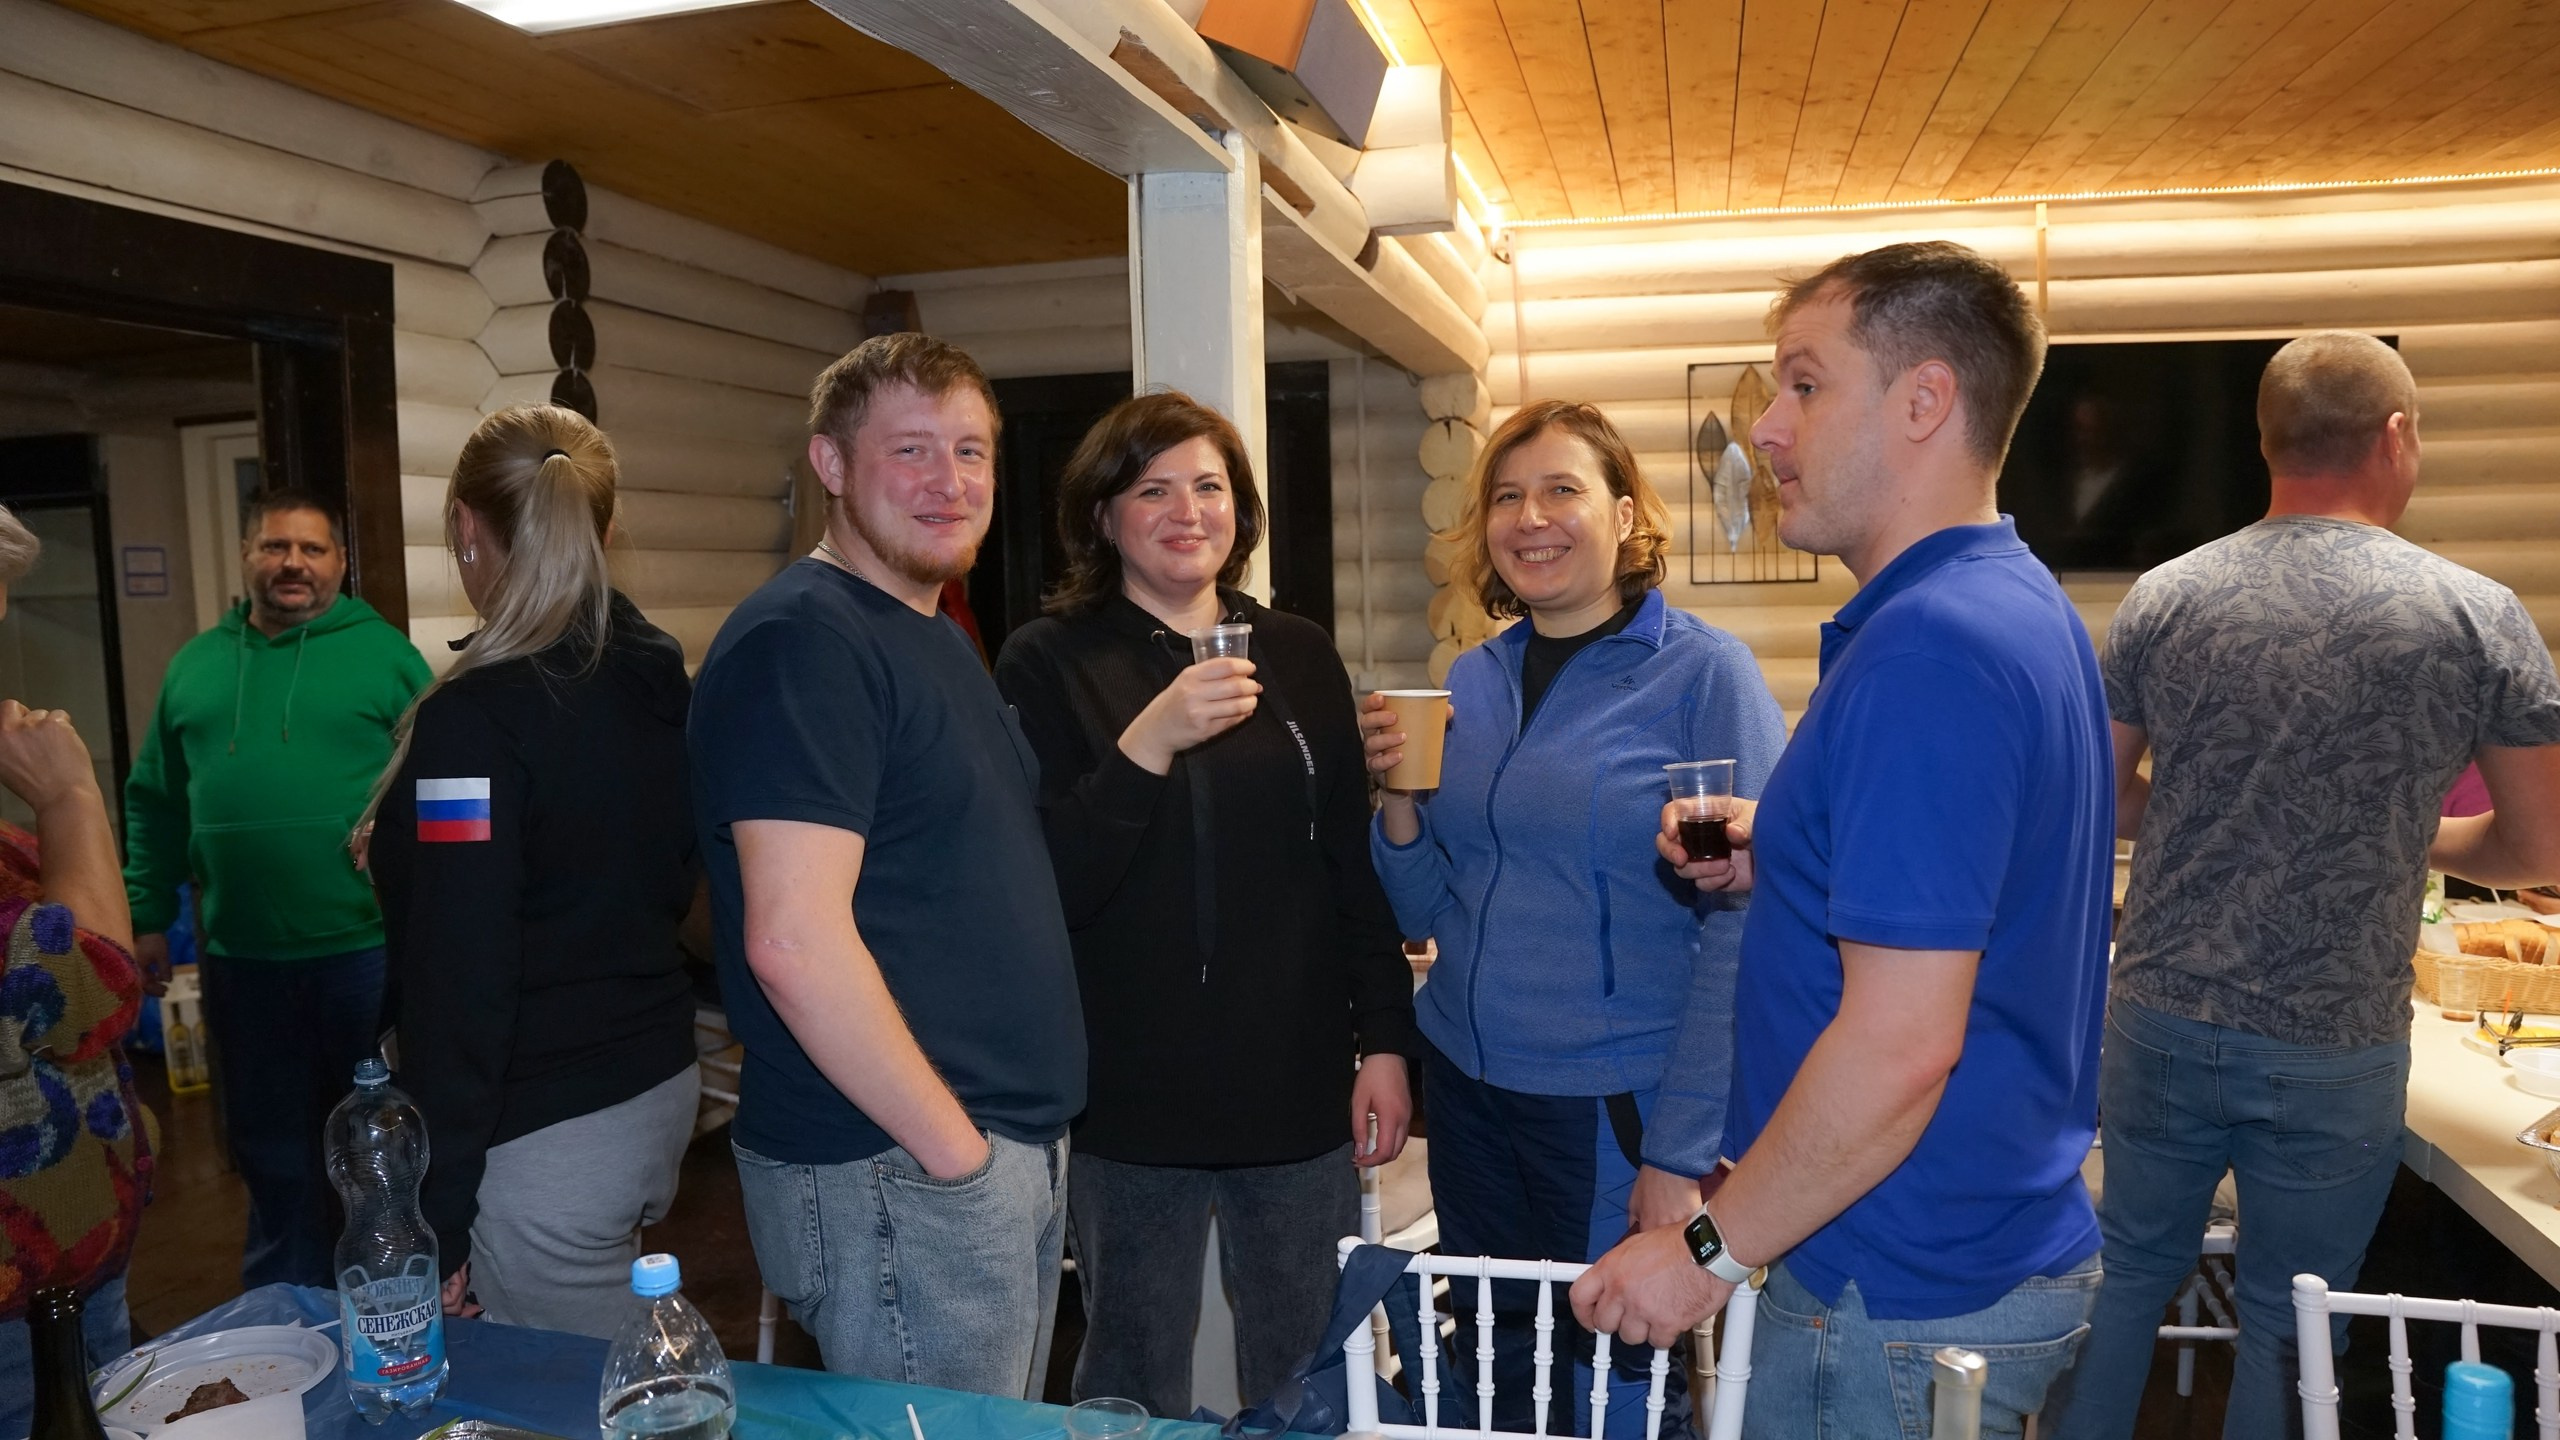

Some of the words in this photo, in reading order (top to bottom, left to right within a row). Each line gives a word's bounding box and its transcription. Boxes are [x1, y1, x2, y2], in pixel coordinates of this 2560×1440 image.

[1286, 720, 1315, 775] JILSANDER
[357, 1299, 437, 1334] СЕНЕЖСКАЯ
[382, 1357, 429, 1374] ГАЗИРОВАННАЯ
